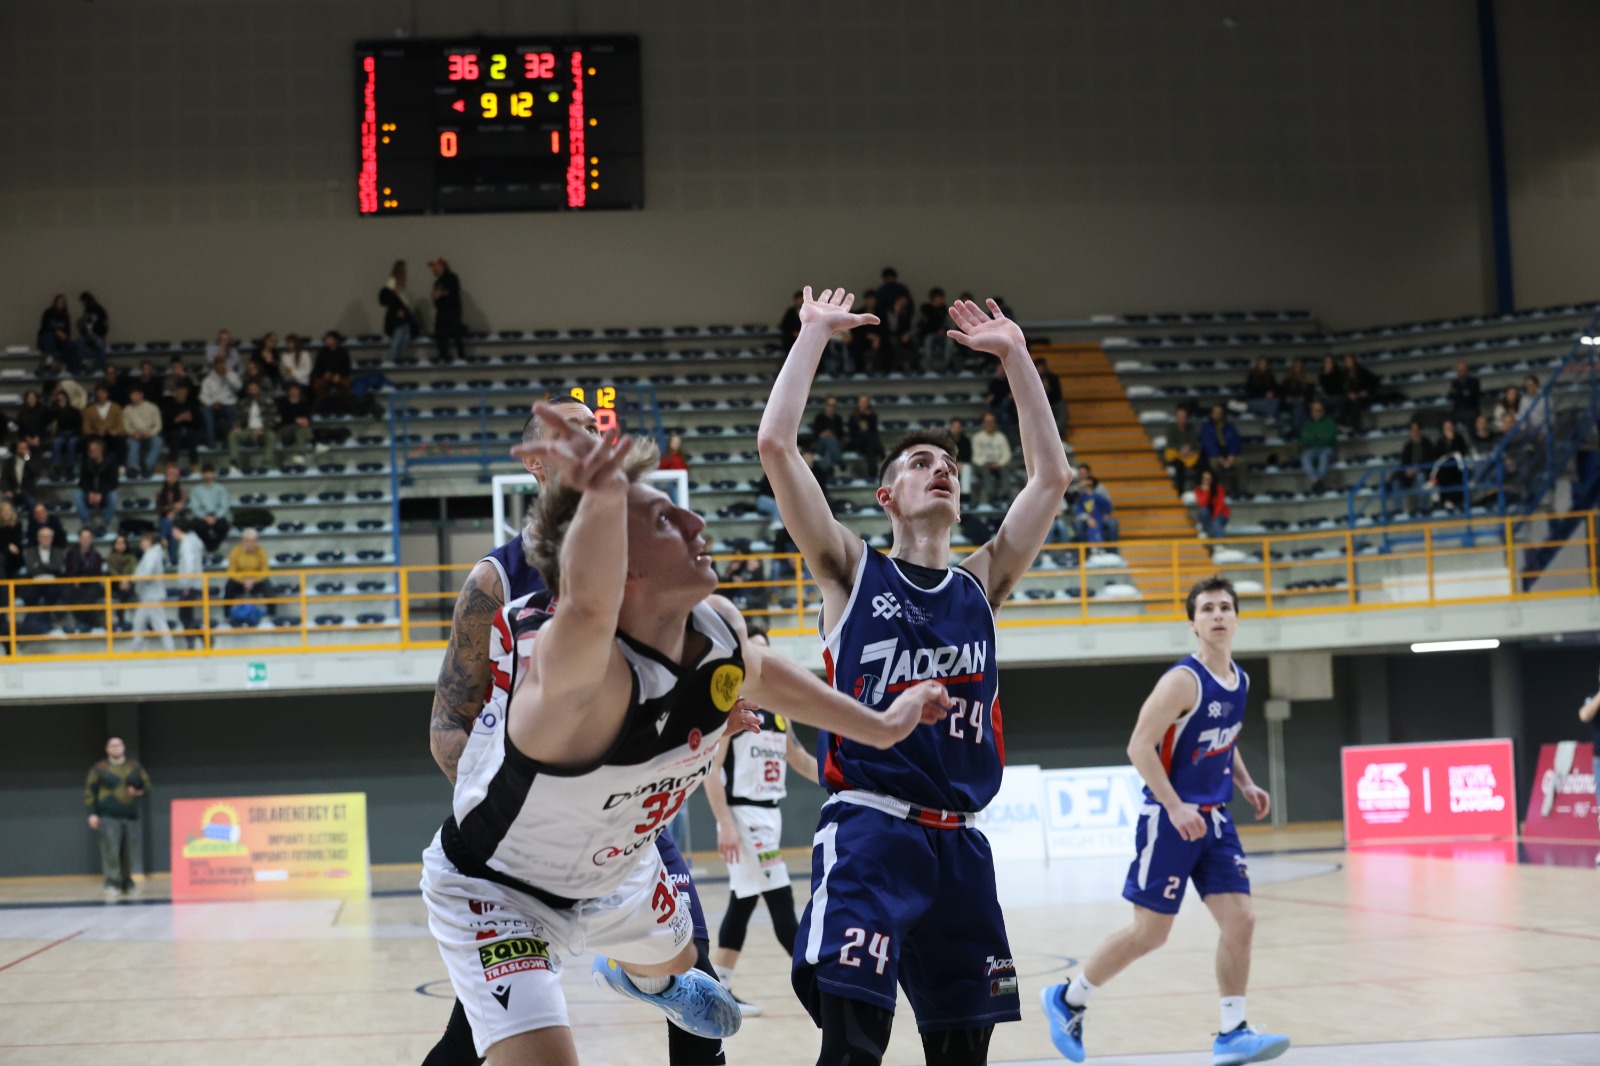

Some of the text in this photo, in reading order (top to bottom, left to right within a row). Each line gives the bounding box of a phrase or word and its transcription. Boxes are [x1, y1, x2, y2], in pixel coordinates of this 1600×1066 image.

[448, 54, 480, 80] 36
[490, 54, 507, 80] 2
[524, 53, 556, 79] 32
[480, 92, 533, 118] 9 12
[440, 131, 458, 157] 0
[551, 130, 560, 153] 1
[597, 386, 616, 409] 12
[860, 637, 987, 704] JADRAN
[949, 696, 983, 744] 24
[602, 758, 713, 811] Dinam
[1163, 875, 1180, 900] 2
[839, 927, 890, 975] 24
